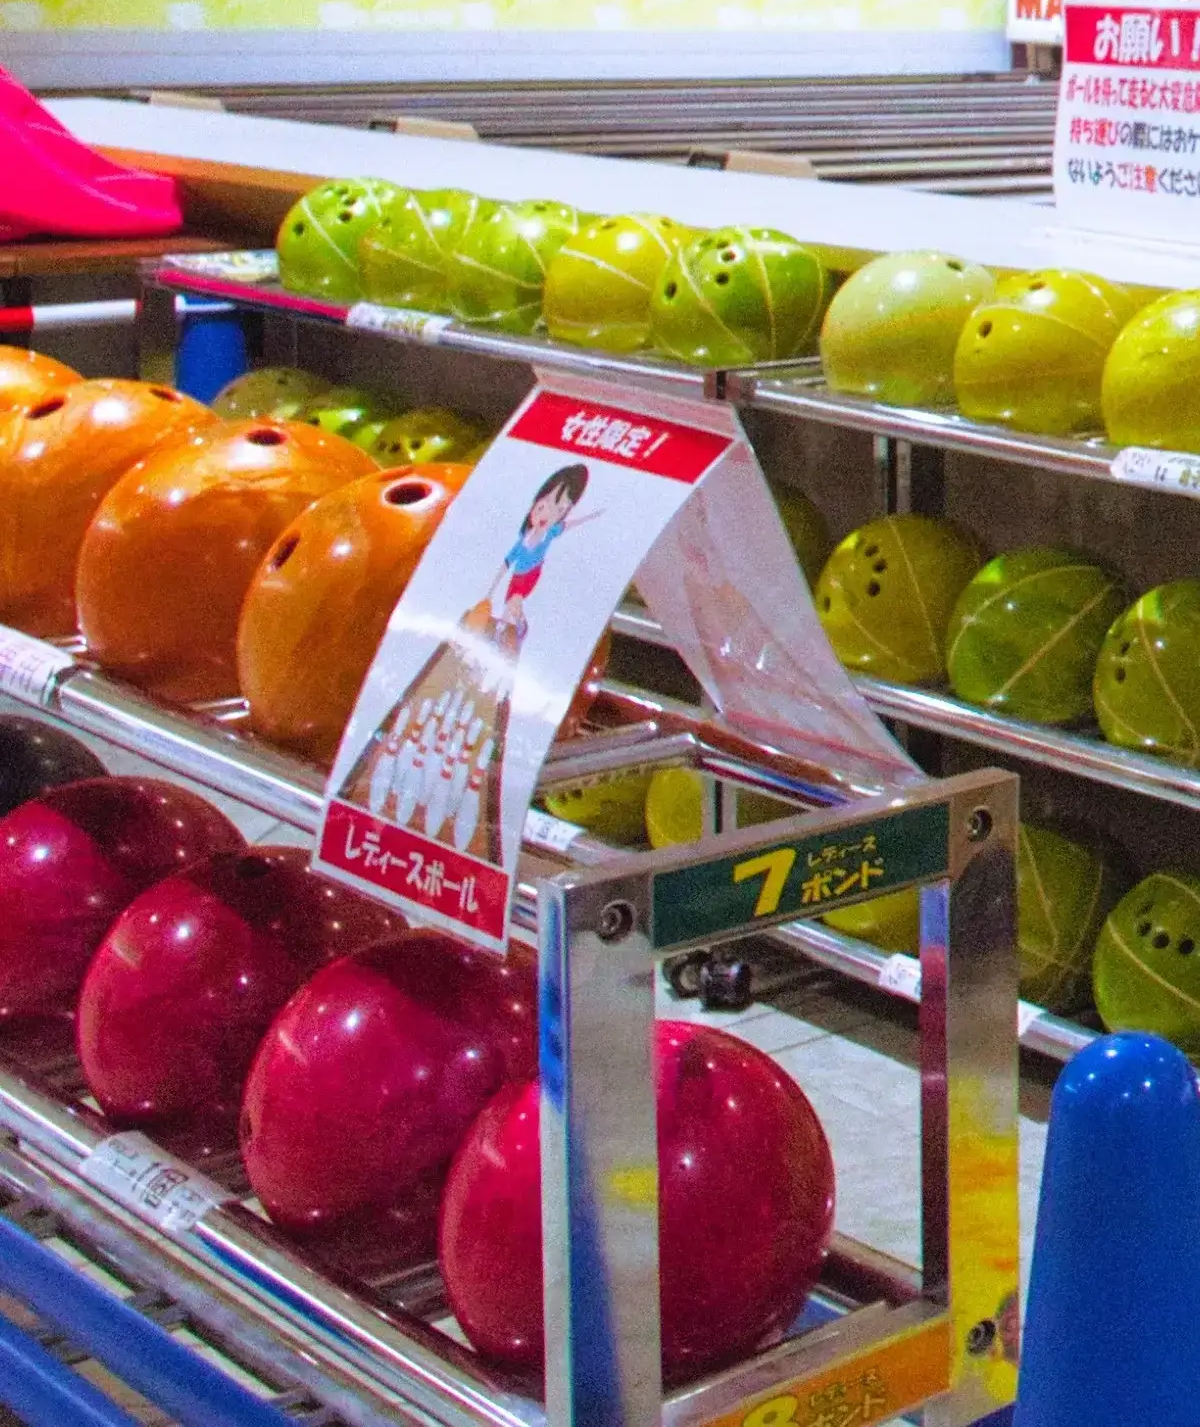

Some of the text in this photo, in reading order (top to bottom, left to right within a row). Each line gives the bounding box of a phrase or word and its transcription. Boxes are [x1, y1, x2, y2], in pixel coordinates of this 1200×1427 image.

[342, 824, 481, 916] レディースボール
[807, 834, 878, 866] レディース
[732, 848, 797, 918] 7
[801, 856, 885, 904] ポンド
